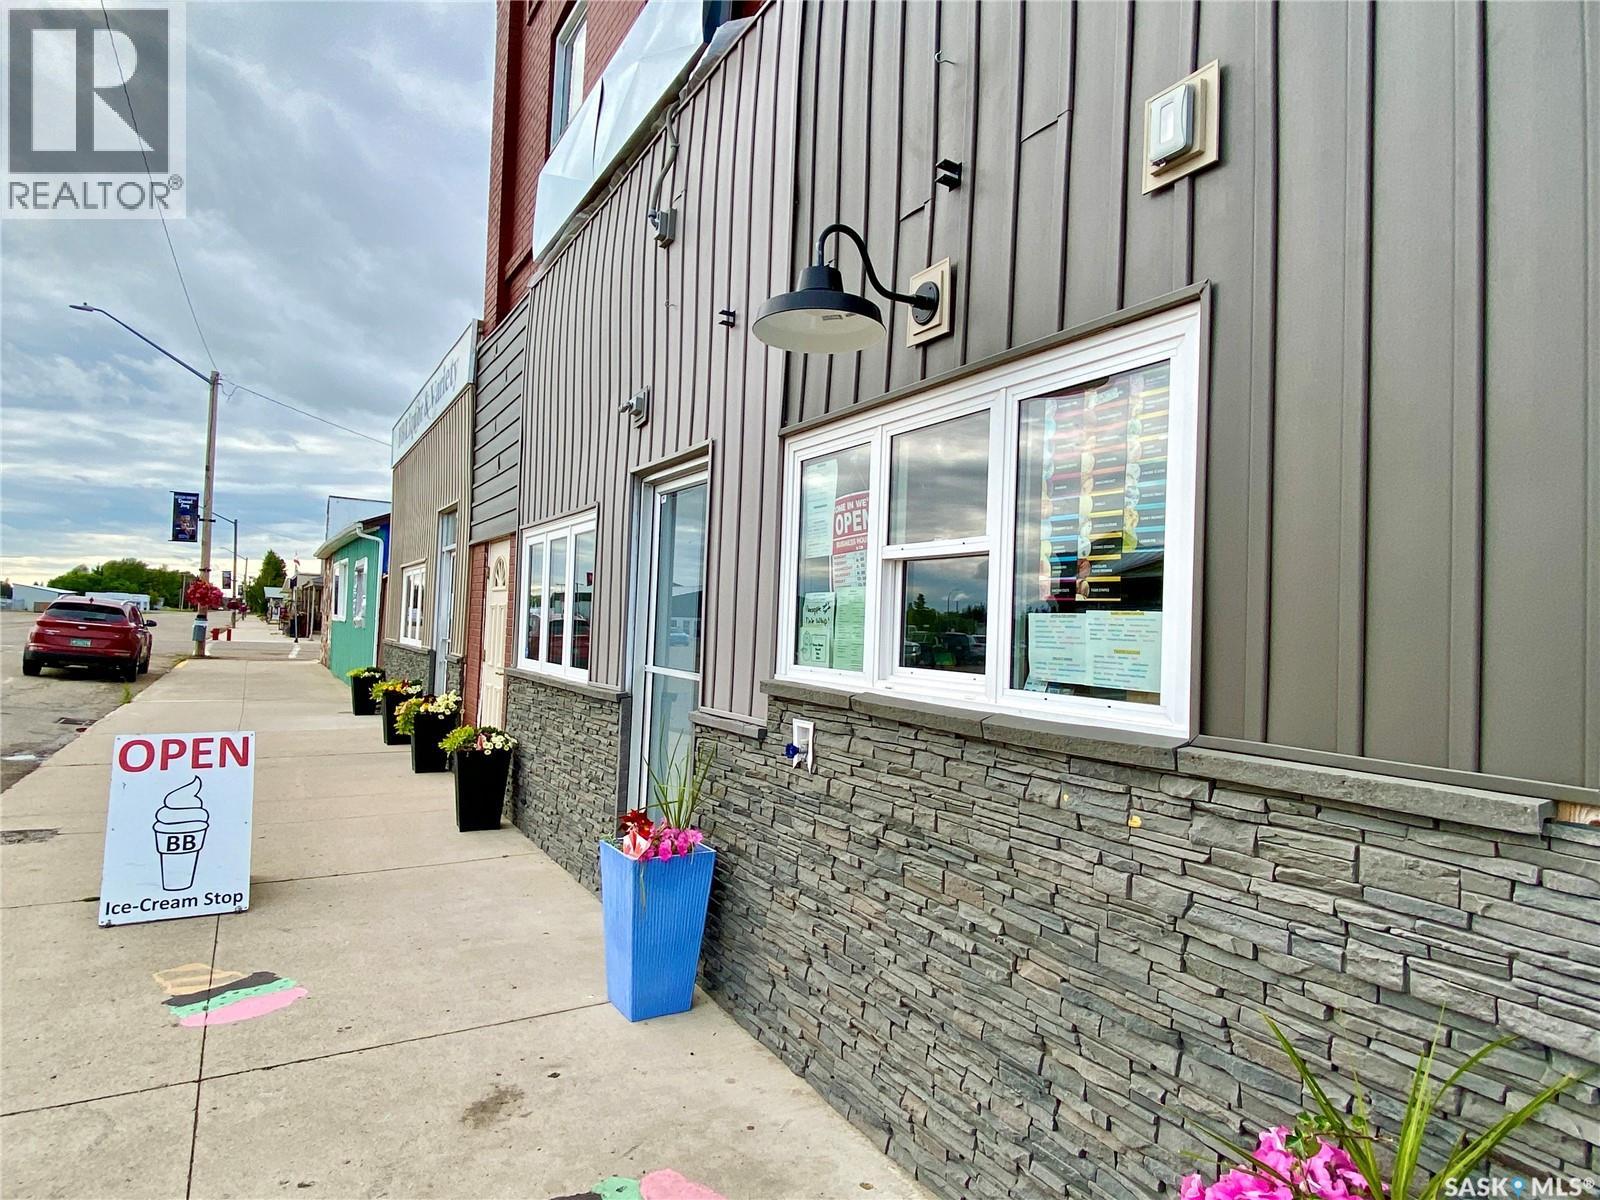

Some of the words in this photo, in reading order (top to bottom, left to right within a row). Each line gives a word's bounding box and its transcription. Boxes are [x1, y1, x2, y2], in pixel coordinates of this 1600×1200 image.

[834, 502, 847, 513] OME
[836, 508, 868, 536] OPEN
[118, 736, 249, 773] OPEN
[166, 835, 197, 852] BB
[105, 896, 198, 915] Ice-Cream
[204, 892, 244, 908] Stop
